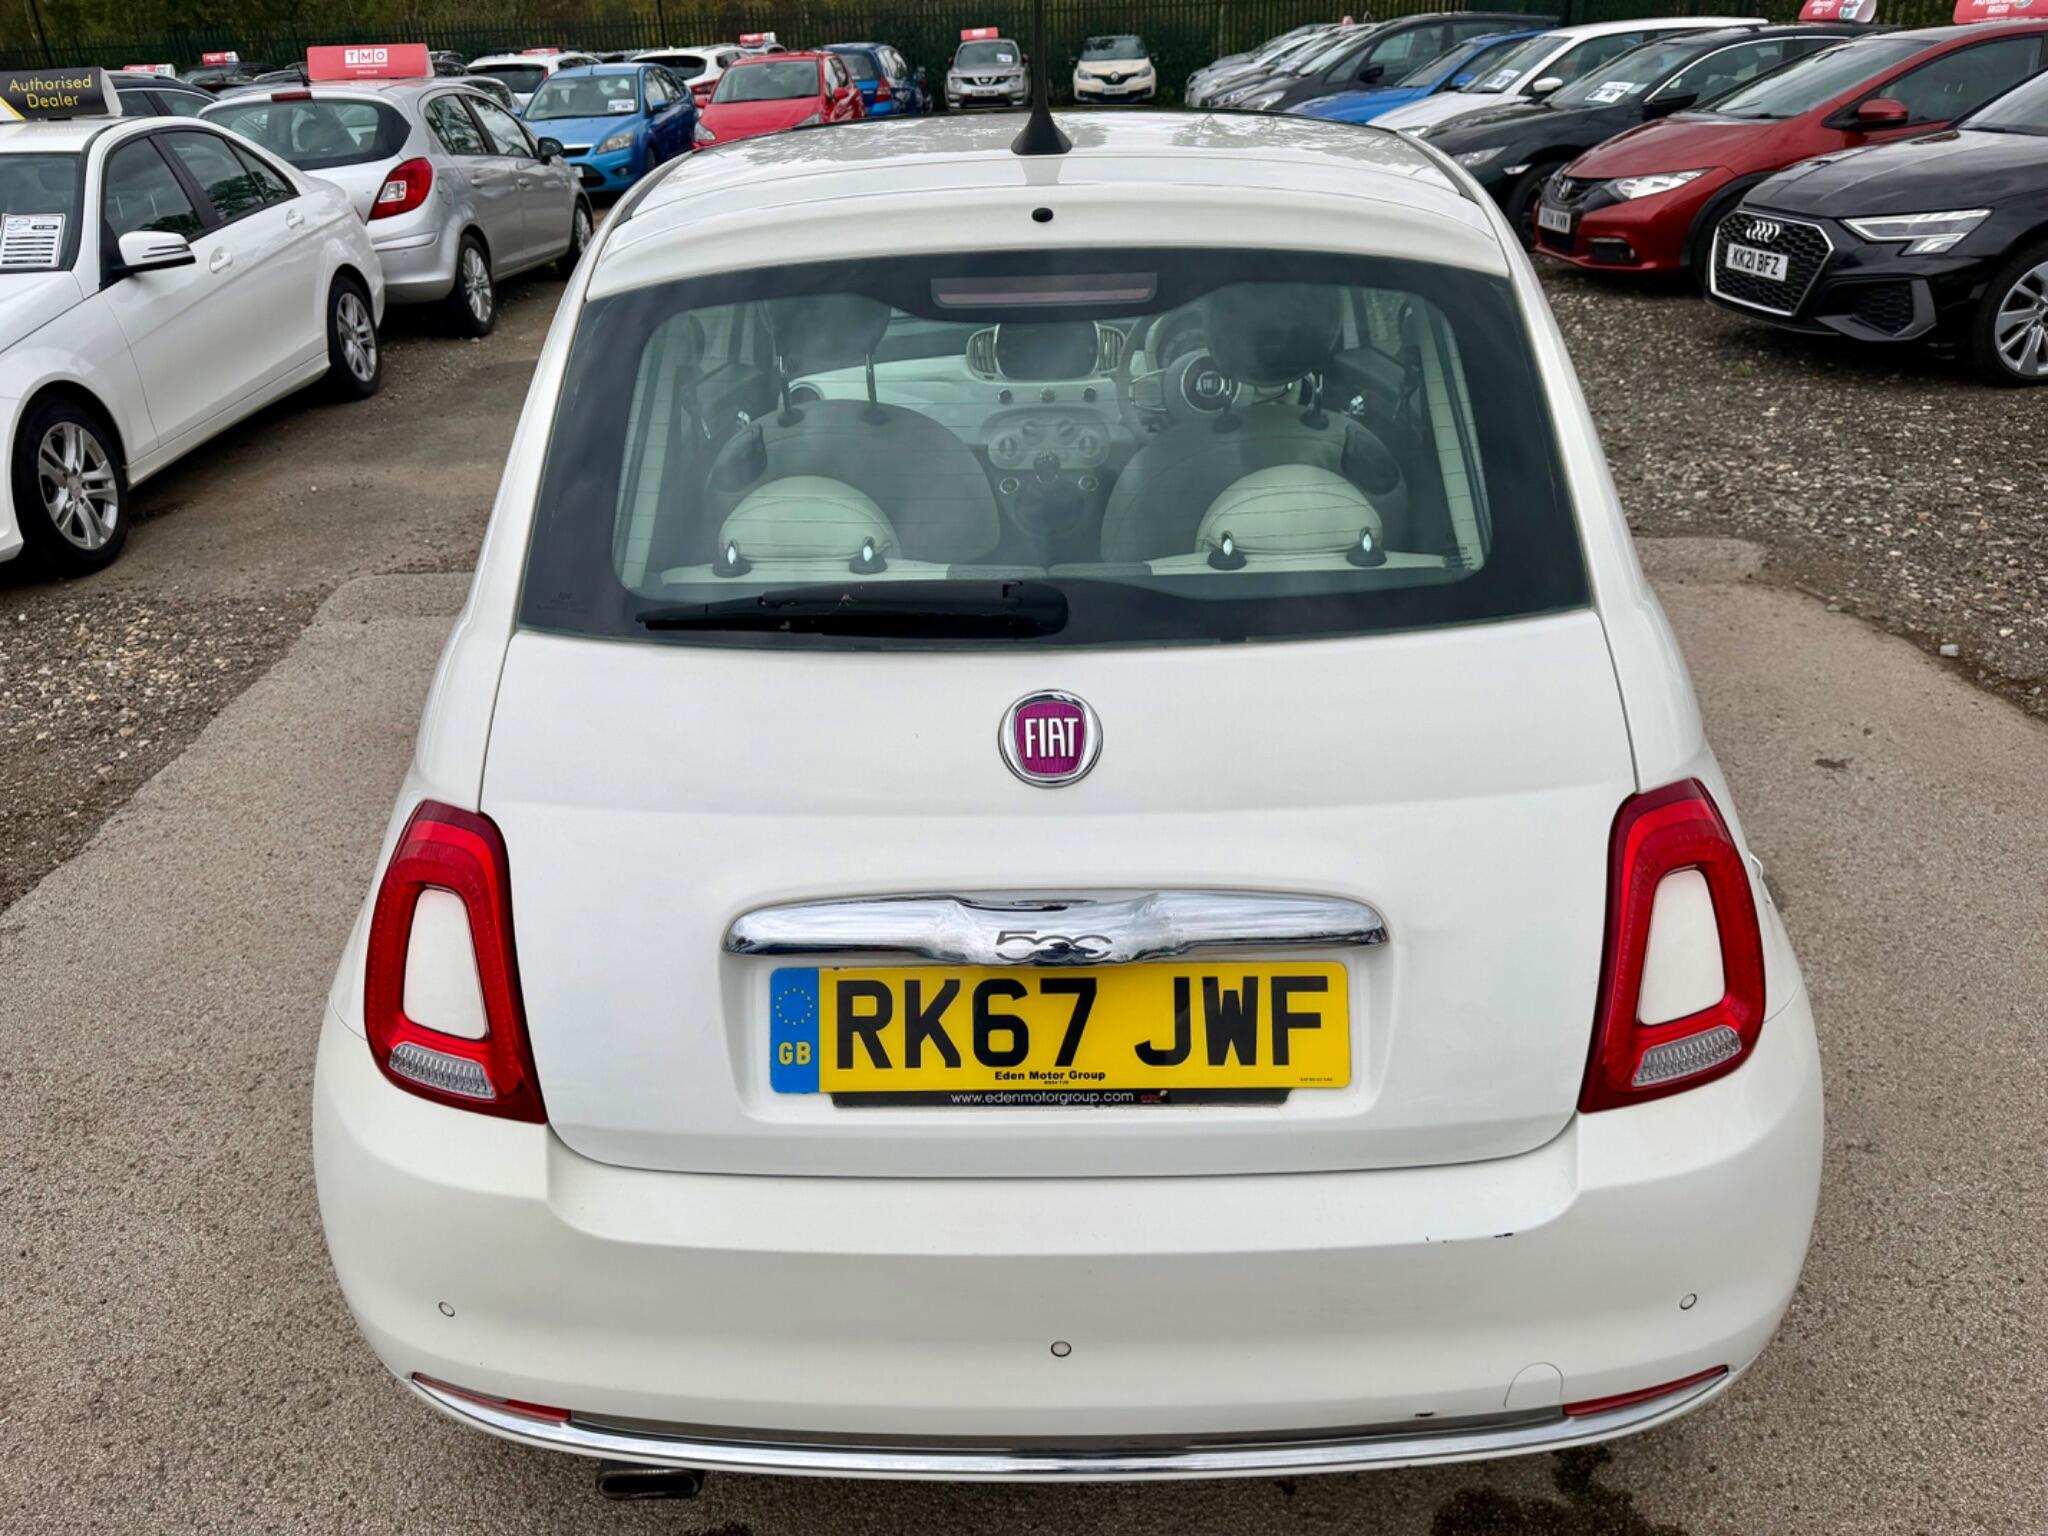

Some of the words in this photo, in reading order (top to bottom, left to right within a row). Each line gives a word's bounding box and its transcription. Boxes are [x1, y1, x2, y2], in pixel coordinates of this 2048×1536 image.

[346, 50, 386, 62] TMO
[9, 73, 92, 92] Authorised
[26, 91, 79, 108] Dealer
[1733, 247, 1756, 270] KK21
[1757, 253, 1779, 276] BFZ
[1024, 717, 1079, 758] FIAT
[995, 930, 1113, 963] 500
[836, 977, 1098, 1070] RK67
[1134, 975, 1328, 1067] JWF
[778, 1041, 812, 1066] GB
[994, 1071, 1025, 1080] Eden
[1029, 1071, 1065, 1080] Motor
[1069, 1070, 1106, 1081] Group
[950, 1091, 1134, 1105] www.edenmotorgroup.com
